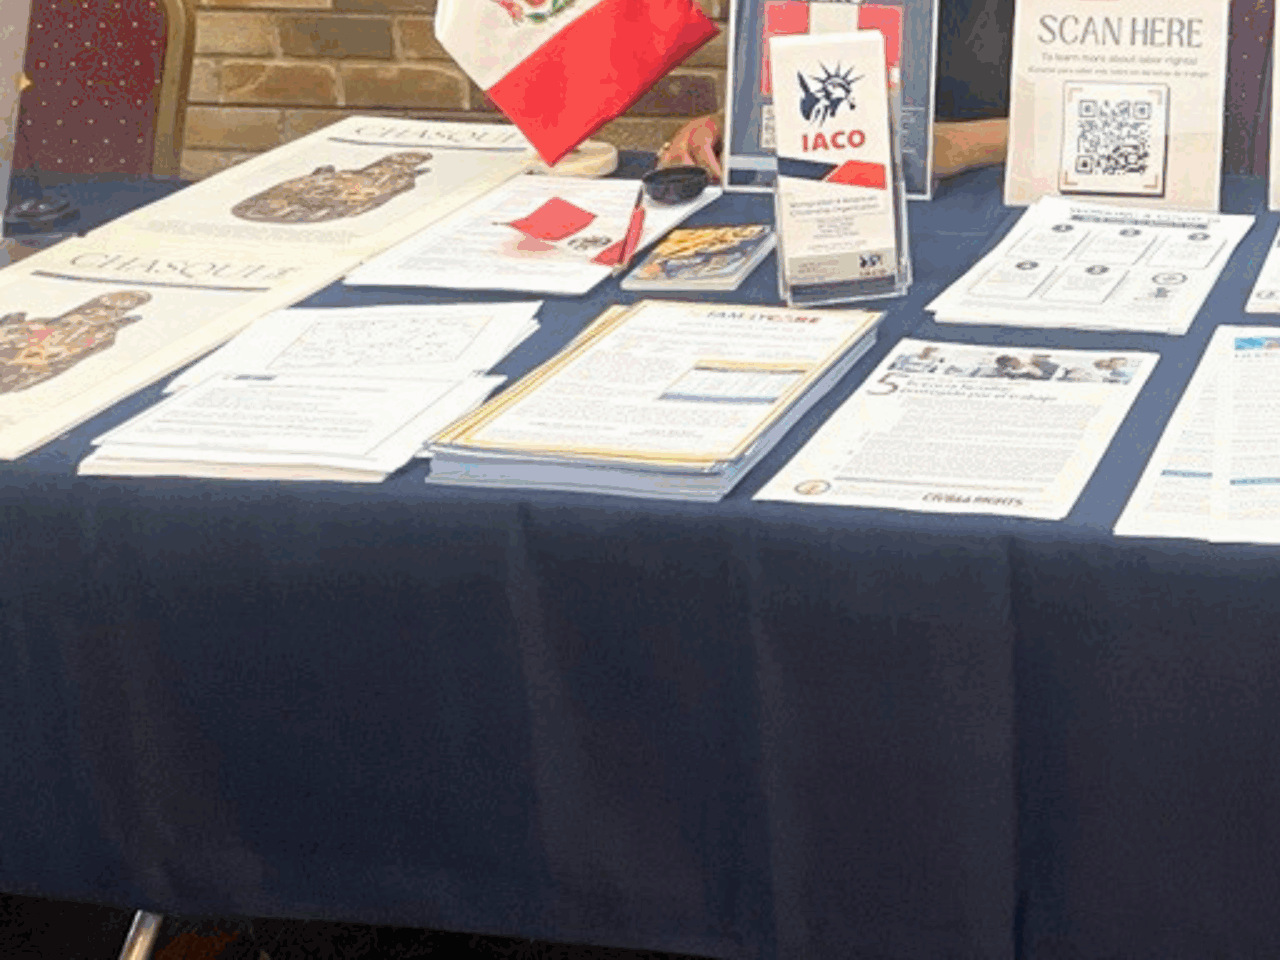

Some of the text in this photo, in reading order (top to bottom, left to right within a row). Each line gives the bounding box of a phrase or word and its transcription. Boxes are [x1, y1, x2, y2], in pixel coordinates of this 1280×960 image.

[1038, 14, 1203, 48] SCAN HERE
[802, 129, 866, 153] IACO
